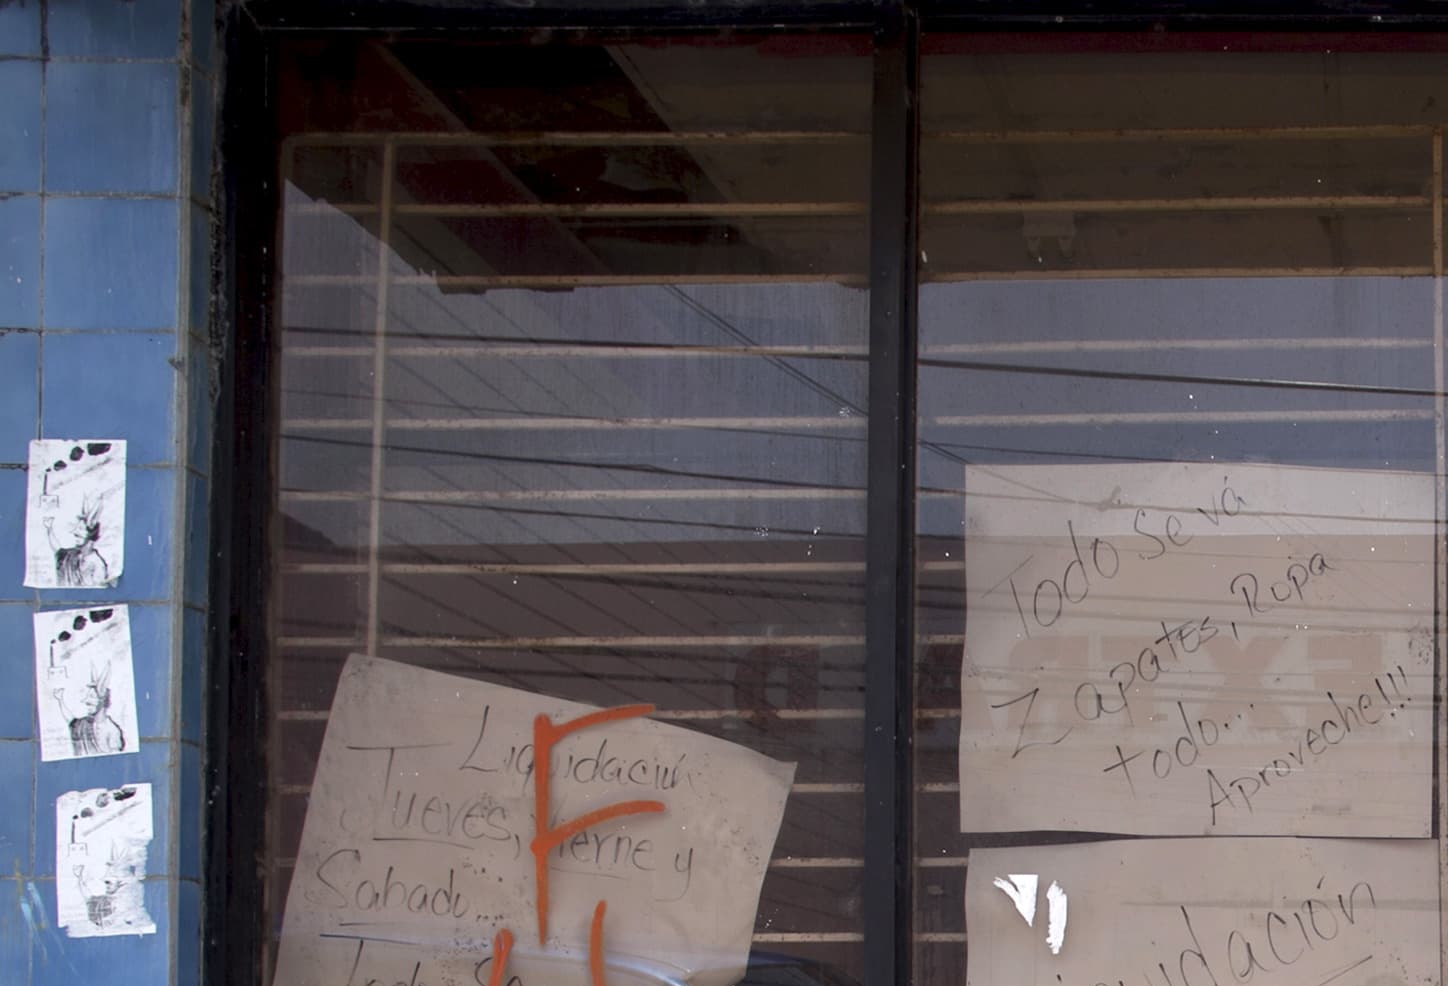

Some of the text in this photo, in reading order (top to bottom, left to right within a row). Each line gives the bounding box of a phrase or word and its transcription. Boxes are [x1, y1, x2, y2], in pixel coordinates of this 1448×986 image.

[982, 519, 1119, 639] Todo
[1231, 552, 1336, 616] Ropa
[459, 704, 698, 792] Liqidación
[655, 848, 695, 900] y
